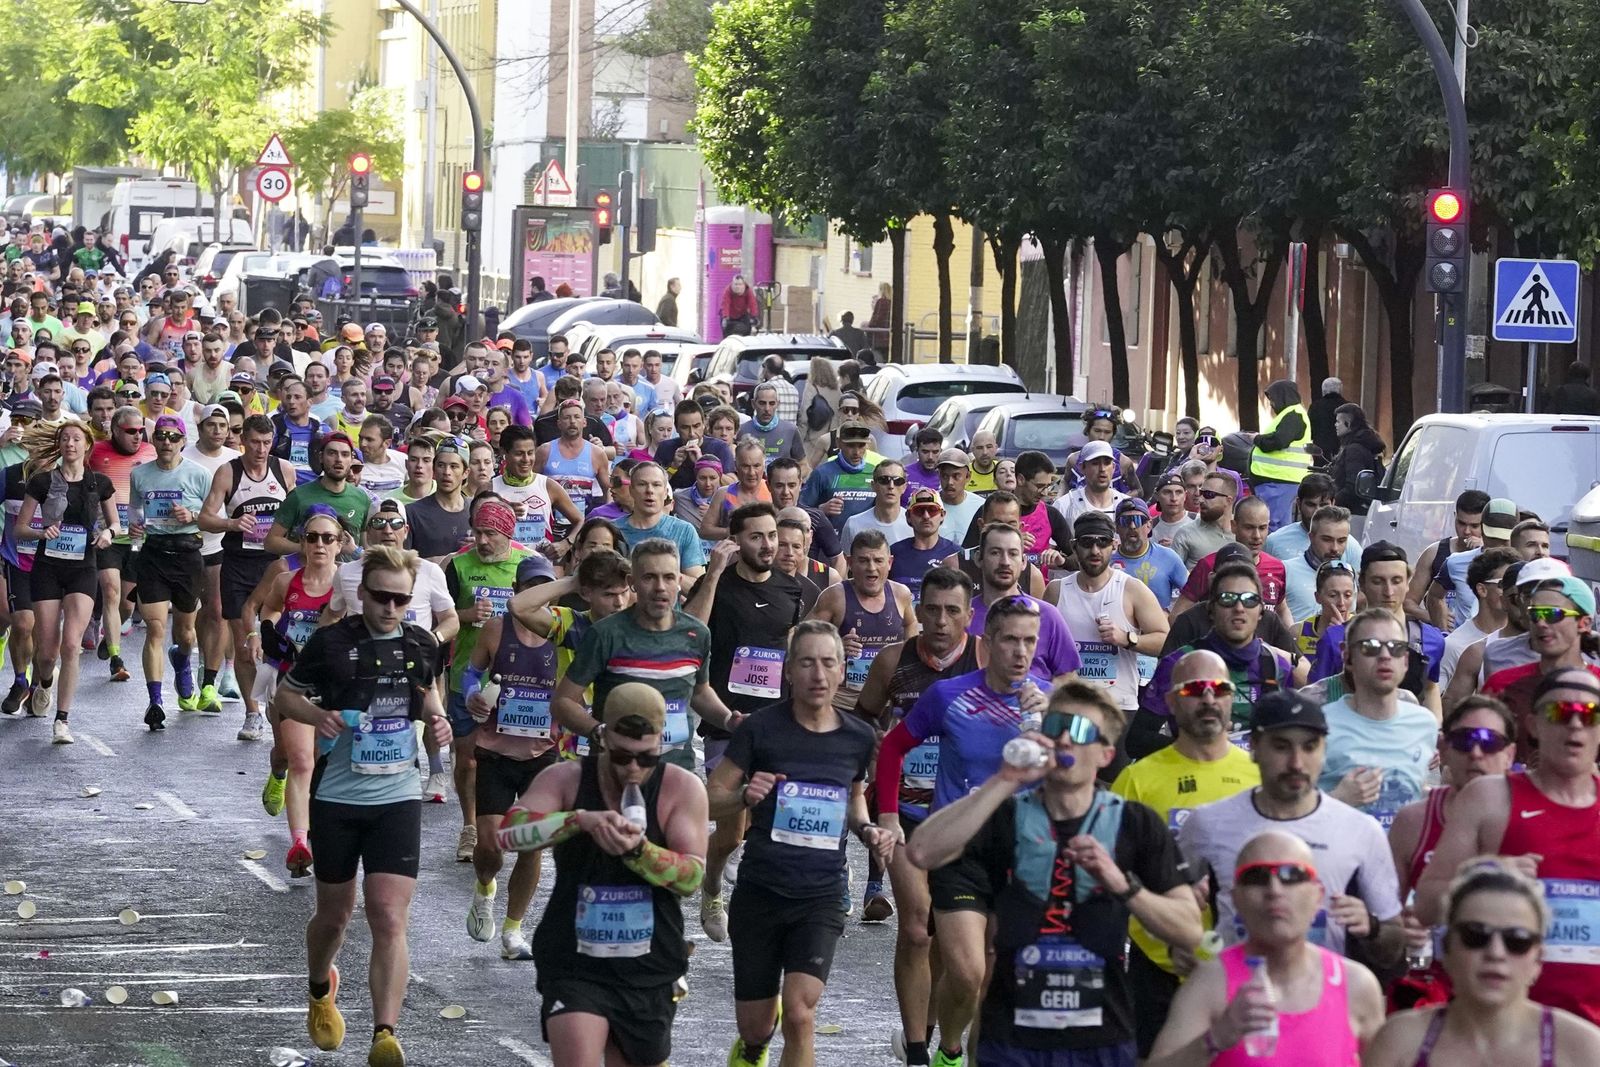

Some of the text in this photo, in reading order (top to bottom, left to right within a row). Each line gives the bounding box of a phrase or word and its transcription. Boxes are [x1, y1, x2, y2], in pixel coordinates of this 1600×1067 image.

[263, 178, 284, 190] 30
[1448, 317, 1455, 326] 2
[243, 502, 280, 513] ISLWYN
[61, 524, 84, 532] ZURICH
[56, 543, 76, 551] FOXY
[1084, 644, 1113, 652] ZURICH
[752, 650, 781, 660] ZURICH
[749, 664, 769, 673] 11065
[744, 673, 769, 686] JOSE
[518, 691, 548, 700] ZURICH
[517, 705, 534, 713] 9208
[666, 703, 679, 711] ICH
[502, 713, 546, 726] ANTONIO
[376, 721, 406, 732] ZURICH
[360, 748, 405, 762] MICHIEL
[924, 752, 938, 760] 687
[802, 788, 840, 799] ZURICH
[801, 806, 821, 815] 9421
[788, 816, 829, 833] CÉSAR
[1552, 883, 1599, 896] ZURICH
[601, 890, 643, 901] ZURICH
[601, 912, 626, 922] 7418
[617, 927, 652, 941] ALVES
[1046, 949, 1096, 962] ZURICH
[1040, 990, 1081, 1009] GERI
